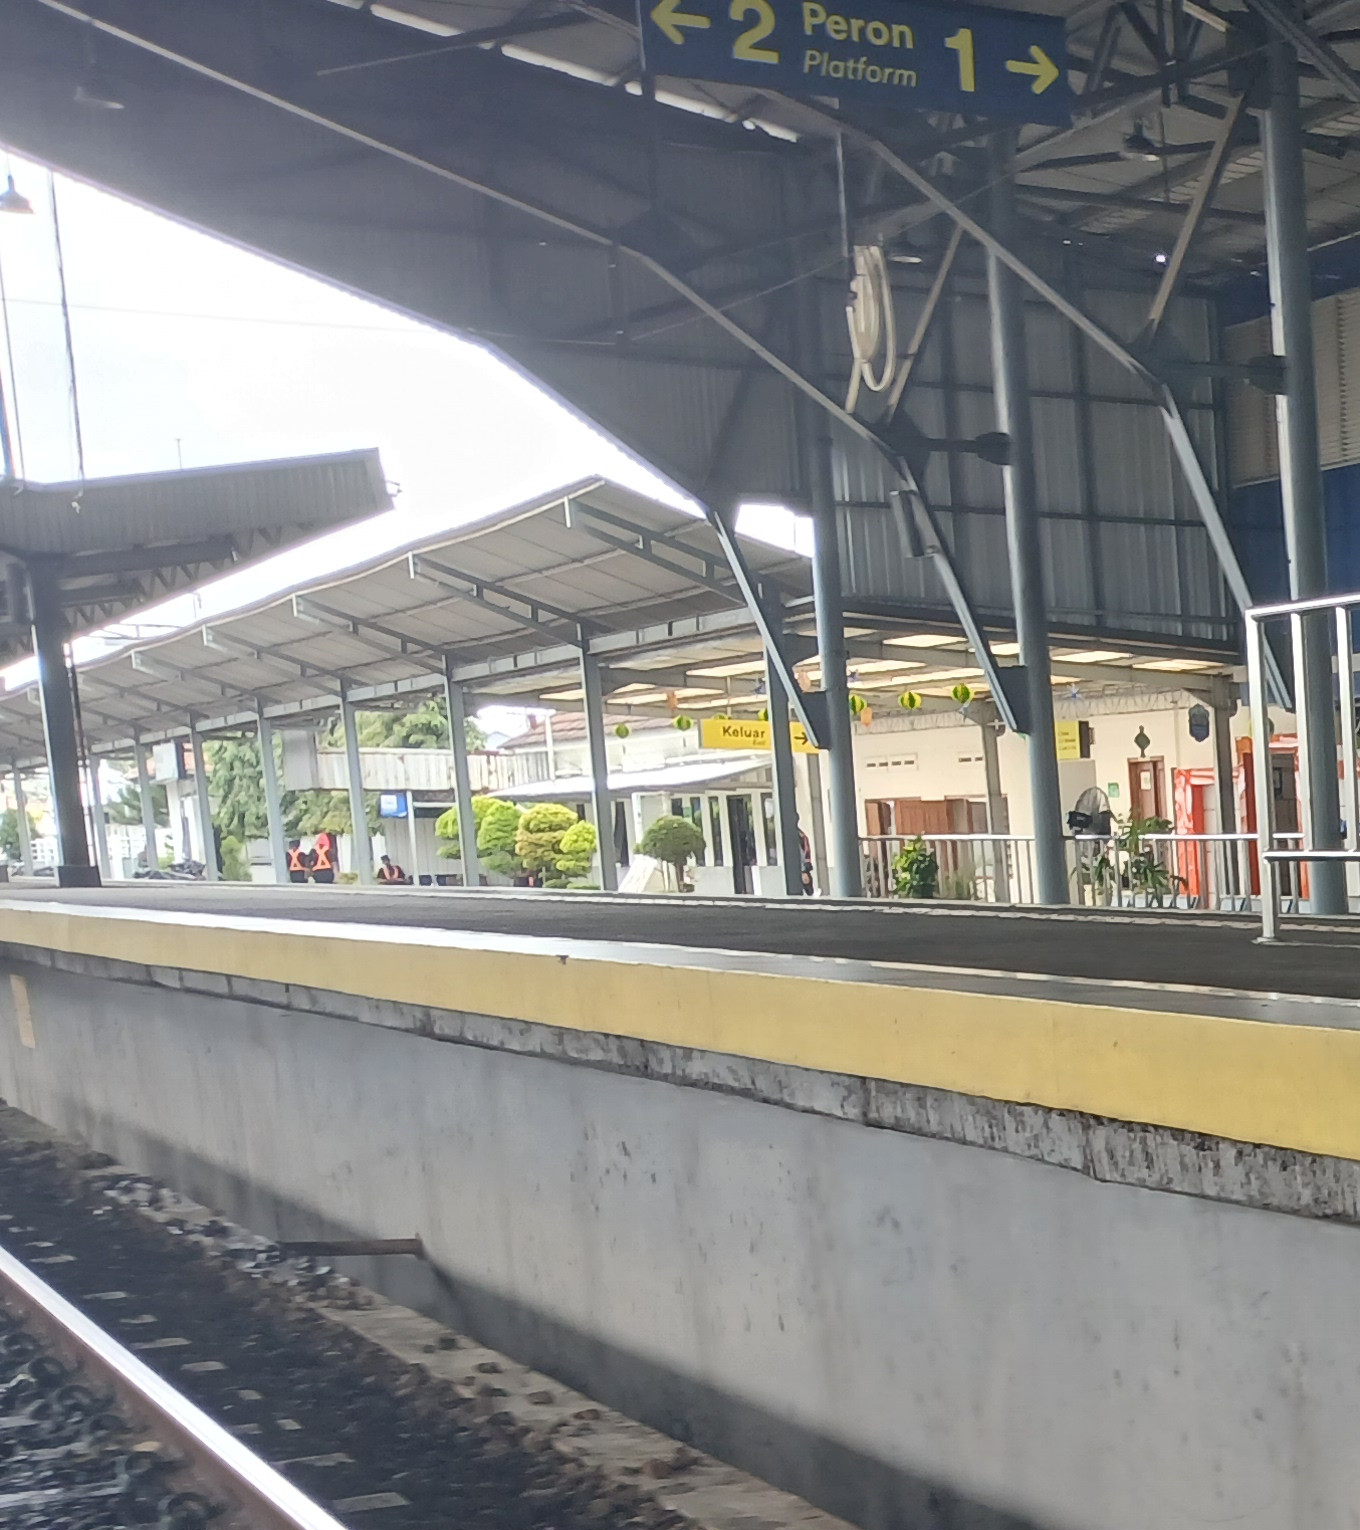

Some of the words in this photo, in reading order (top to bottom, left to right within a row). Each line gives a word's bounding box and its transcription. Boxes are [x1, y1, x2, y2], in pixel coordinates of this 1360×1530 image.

[729, 0, 780, 64] 2
[803, 2, 914, 49] Peron
[803, 49, 917, 87] Platform
[944, 28, 975, 92] 1
[722, 725, 766, 739] Keluar
